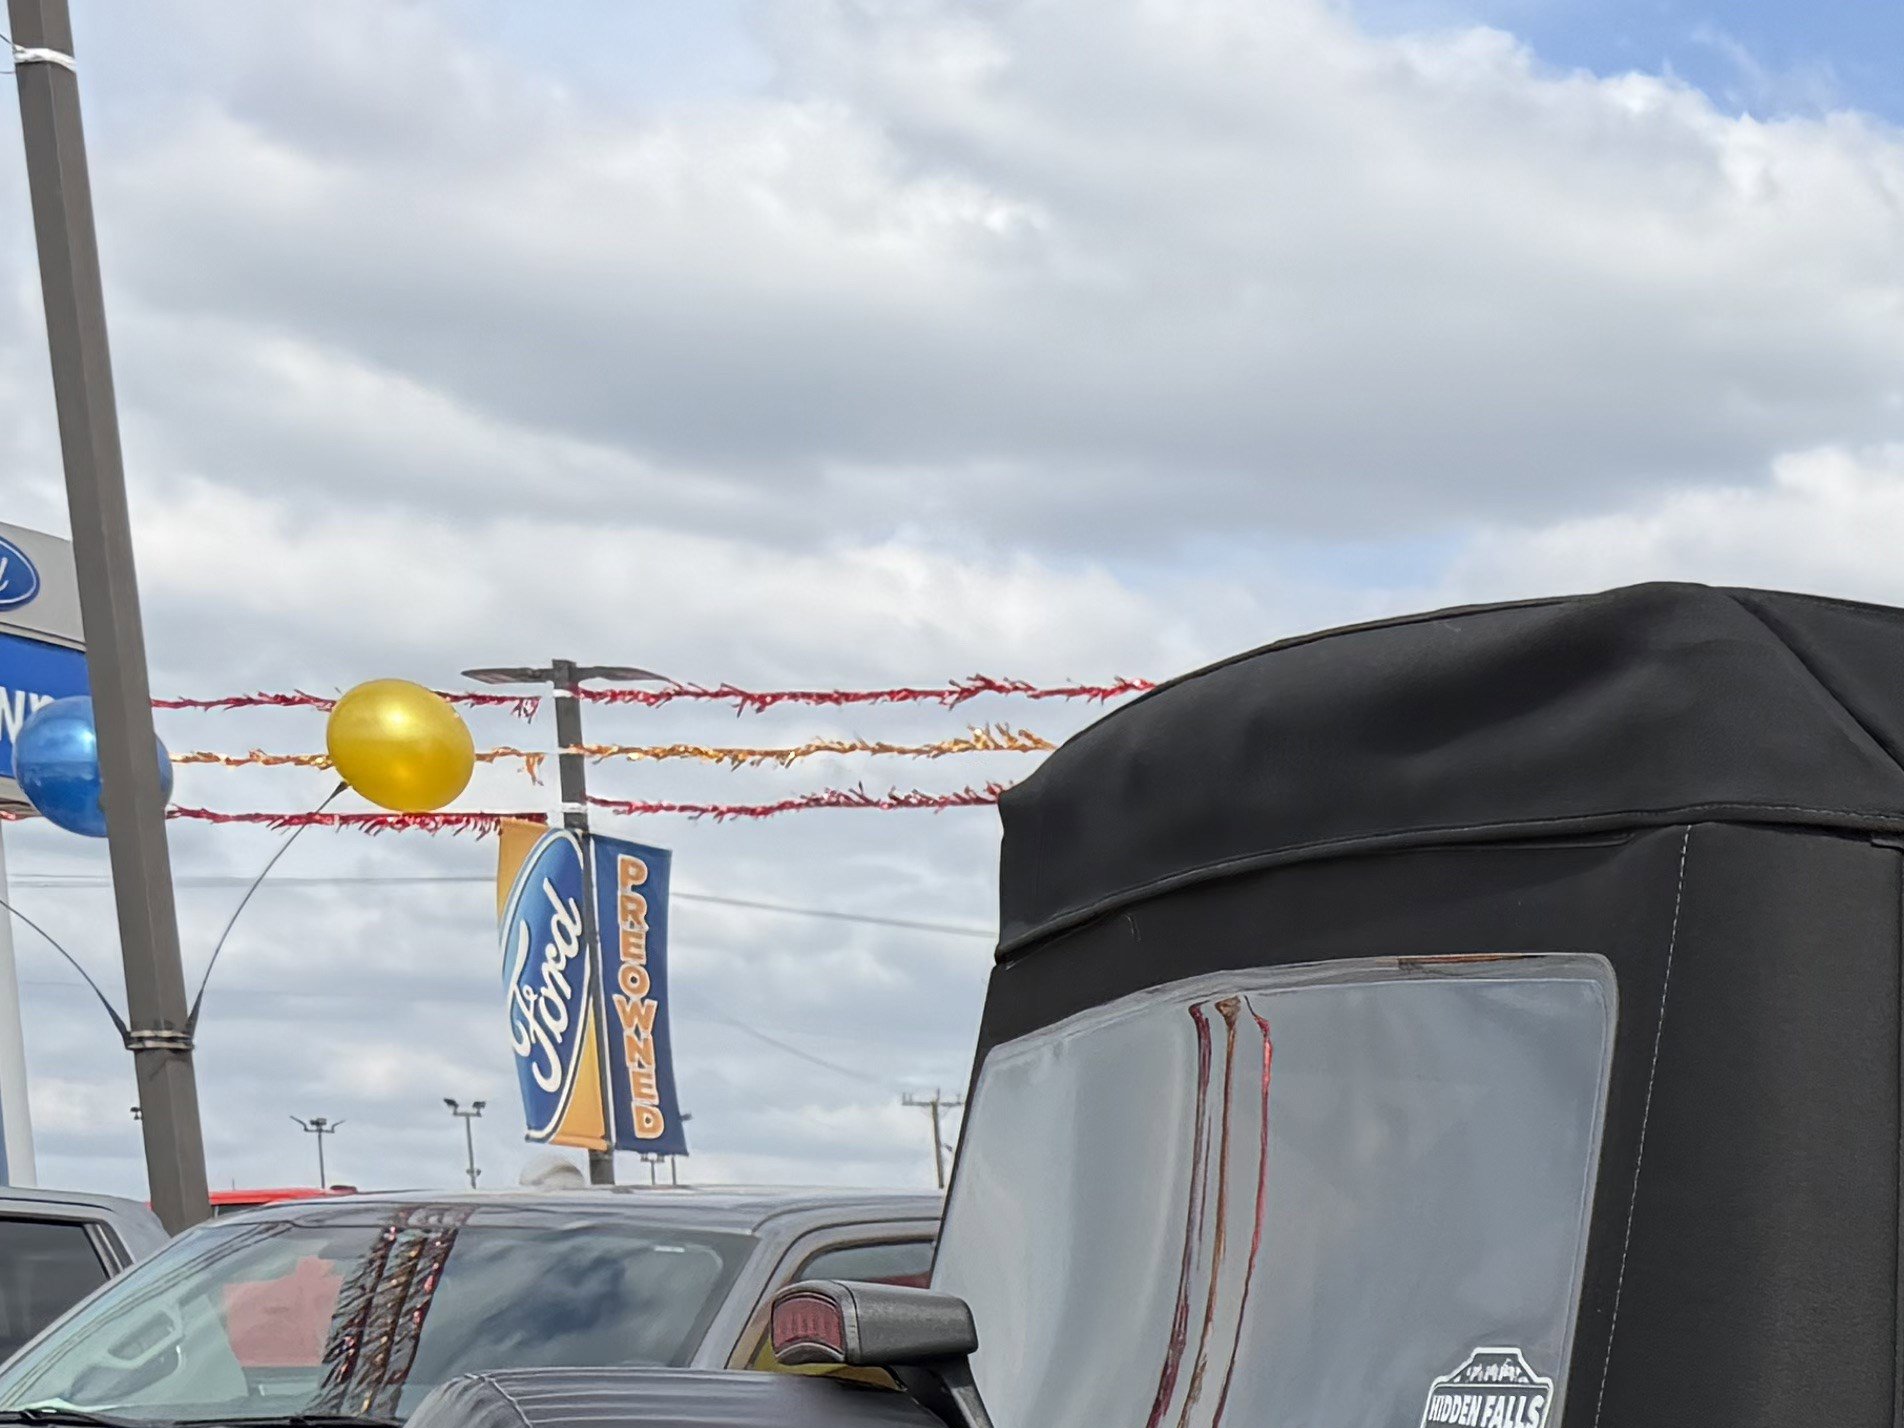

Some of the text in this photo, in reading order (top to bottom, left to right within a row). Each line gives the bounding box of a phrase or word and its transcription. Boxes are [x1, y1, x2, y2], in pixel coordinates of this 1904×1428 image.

[507, 879, 585, 1093] Ford
[612, 855, 664, 1139] PREOWNED
[1428, 1394, 1482, 1427] HIDDEN
